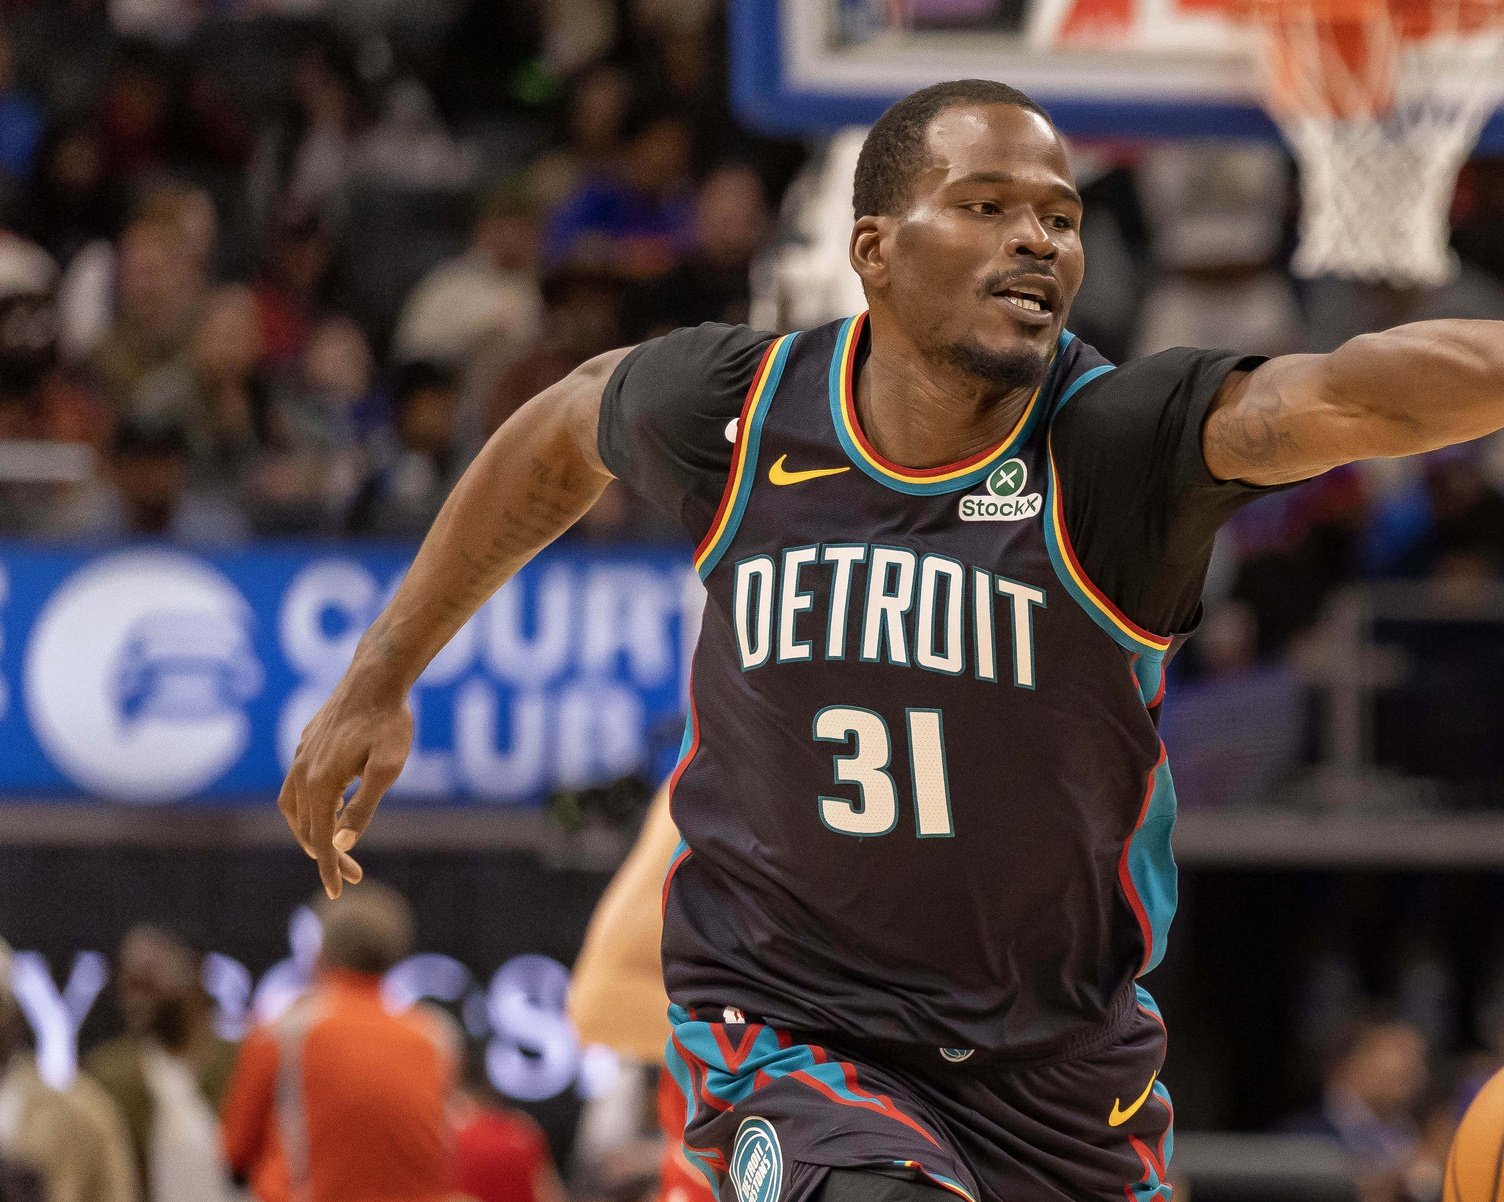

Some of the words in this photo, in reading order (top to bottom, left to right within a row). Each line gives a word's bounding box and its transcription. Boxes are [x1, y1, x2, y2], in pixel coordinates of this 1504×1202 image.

[962, 495, 1039, 517] StockX
[732, 543, 1047, 691] DETROIT
[812, 704, 955, 839] 31
